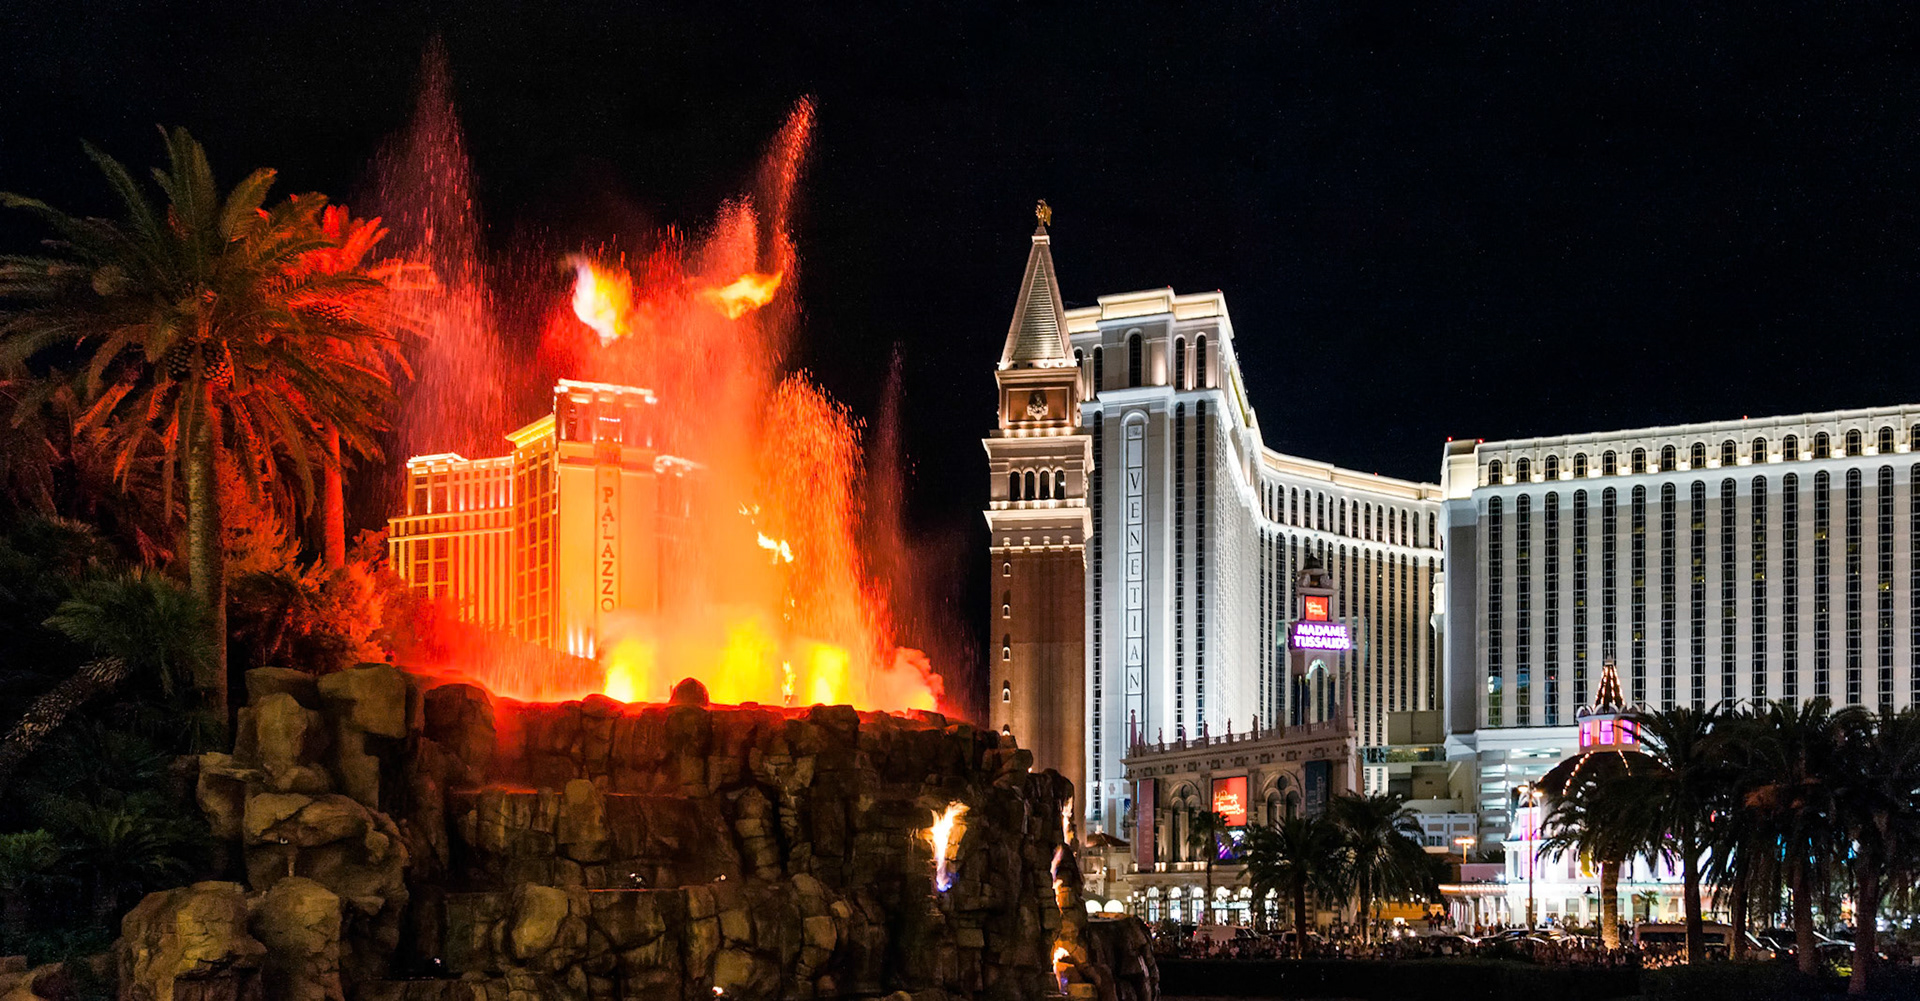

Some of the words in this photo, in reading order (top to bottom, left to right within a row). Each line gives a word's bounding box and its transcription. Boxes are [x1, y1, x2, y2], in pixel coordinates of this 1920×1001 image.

[601, 486, 615, 613] PALAZZO
[1130, 472, 1141, 689] VENETIAN
[1294, 635, 1350, 649] TUSSAUDS
[1297, 624, 1347, 637] MADAME
